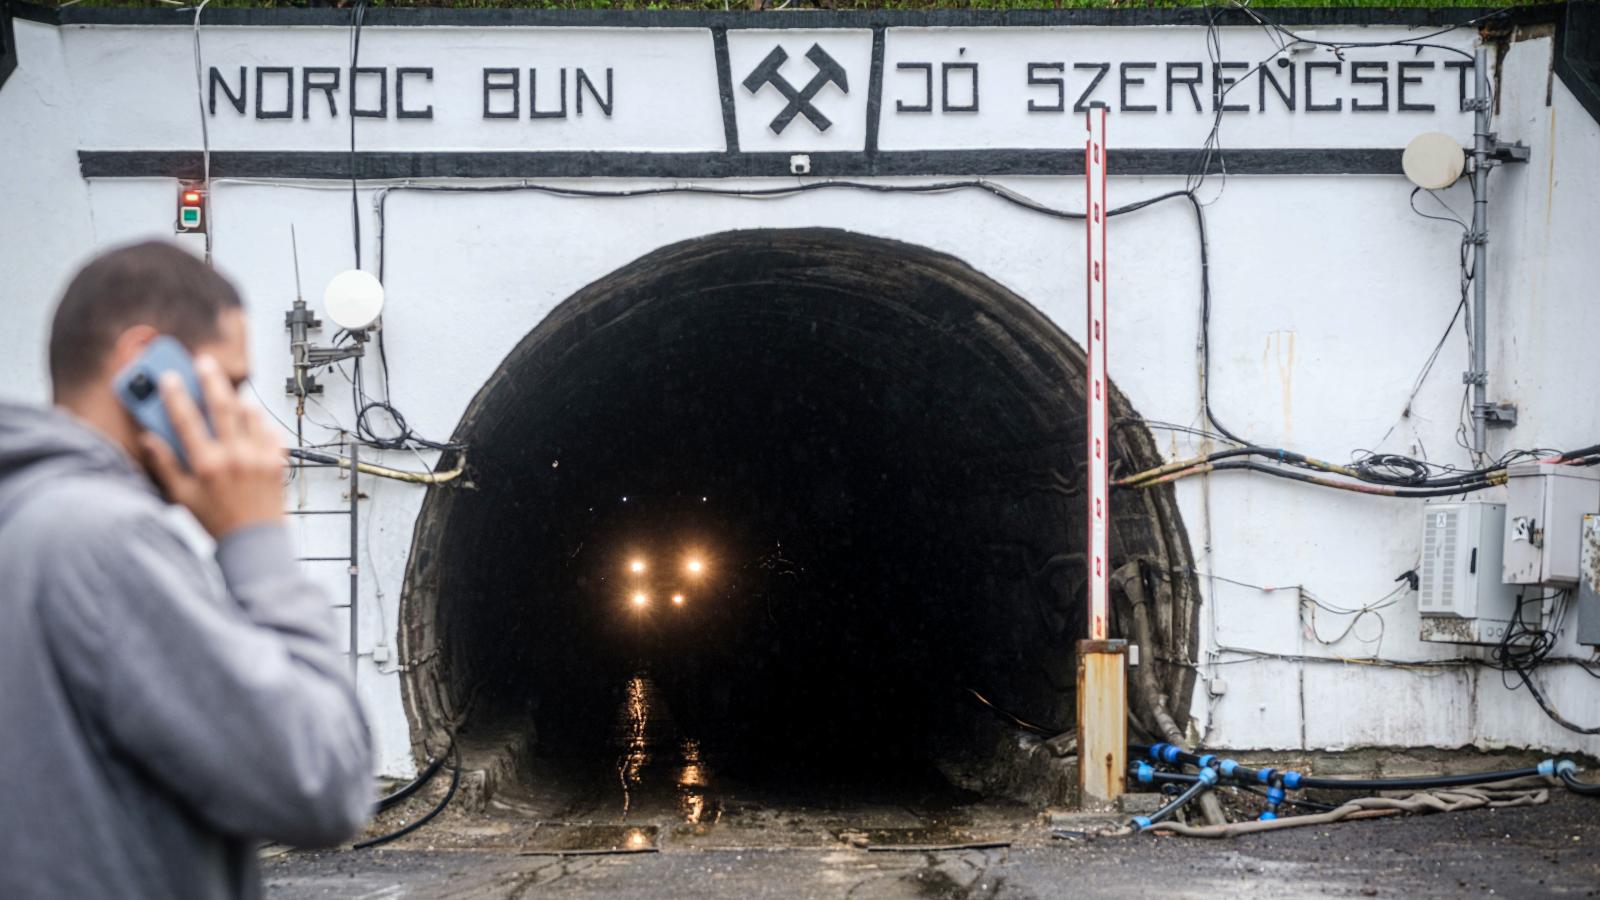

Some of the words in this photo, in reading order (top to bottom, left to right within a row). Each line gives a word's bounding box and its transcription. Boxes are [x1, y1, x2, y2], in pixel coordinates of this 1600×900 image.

[209, 66, 433, 119] NOROC
[483, 67, 613, 119] BUN
[896, 47, 979, 112] JÓ
